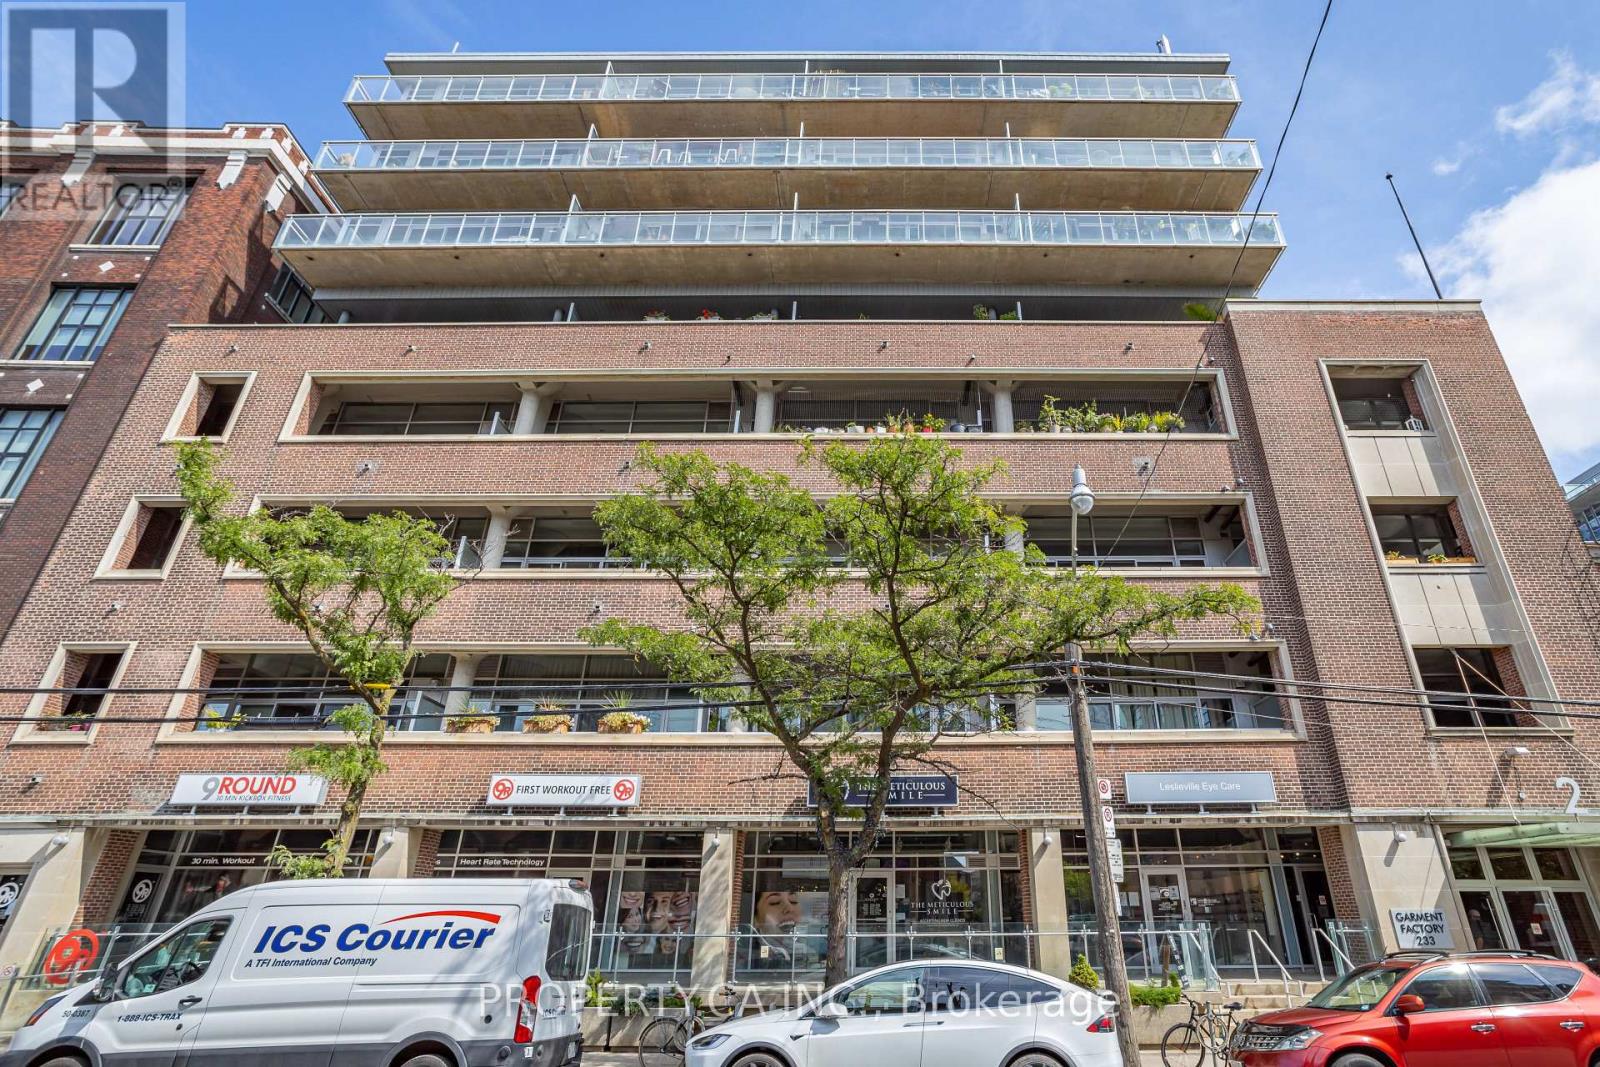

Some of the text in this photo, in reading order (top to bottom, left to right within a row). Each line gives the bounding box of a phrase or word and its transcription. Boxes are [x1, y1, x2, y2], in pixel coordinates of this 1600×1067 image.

[201, 776, 297, 800] 9ROUND
[516, 785, 540, 795] FIRST
[542, 785, 587, 795] WORKOUT
[589, 785, 611, 795] FREE
[889, 781, 946, 791] ETICULOUS
[1202, 783, 1218, 793] Eye
[1220, 781, 1241, 791] Care
[887, 791, 924, 800] MILE
[1556, 776, 1589, 814] 2
[191, 857, 202, 865] 30
[222, 857, 256, 865] Workout
[460, 858, 545, 867] Heart Rate Technology
[1395, 912, 1443, 922] GARMENT
[1400, 924, 1445, 934] FACTORY
[253, 921, 496, 954] ICS Courier
[1415, 935, 1436, 946] 233
[244, 959, 252, 968] A
[271, 957, 333, 967] International
[333, 956, 378, 967] Company
[117, 1012, 183, 1023] 1-888-ICS-TRAX
